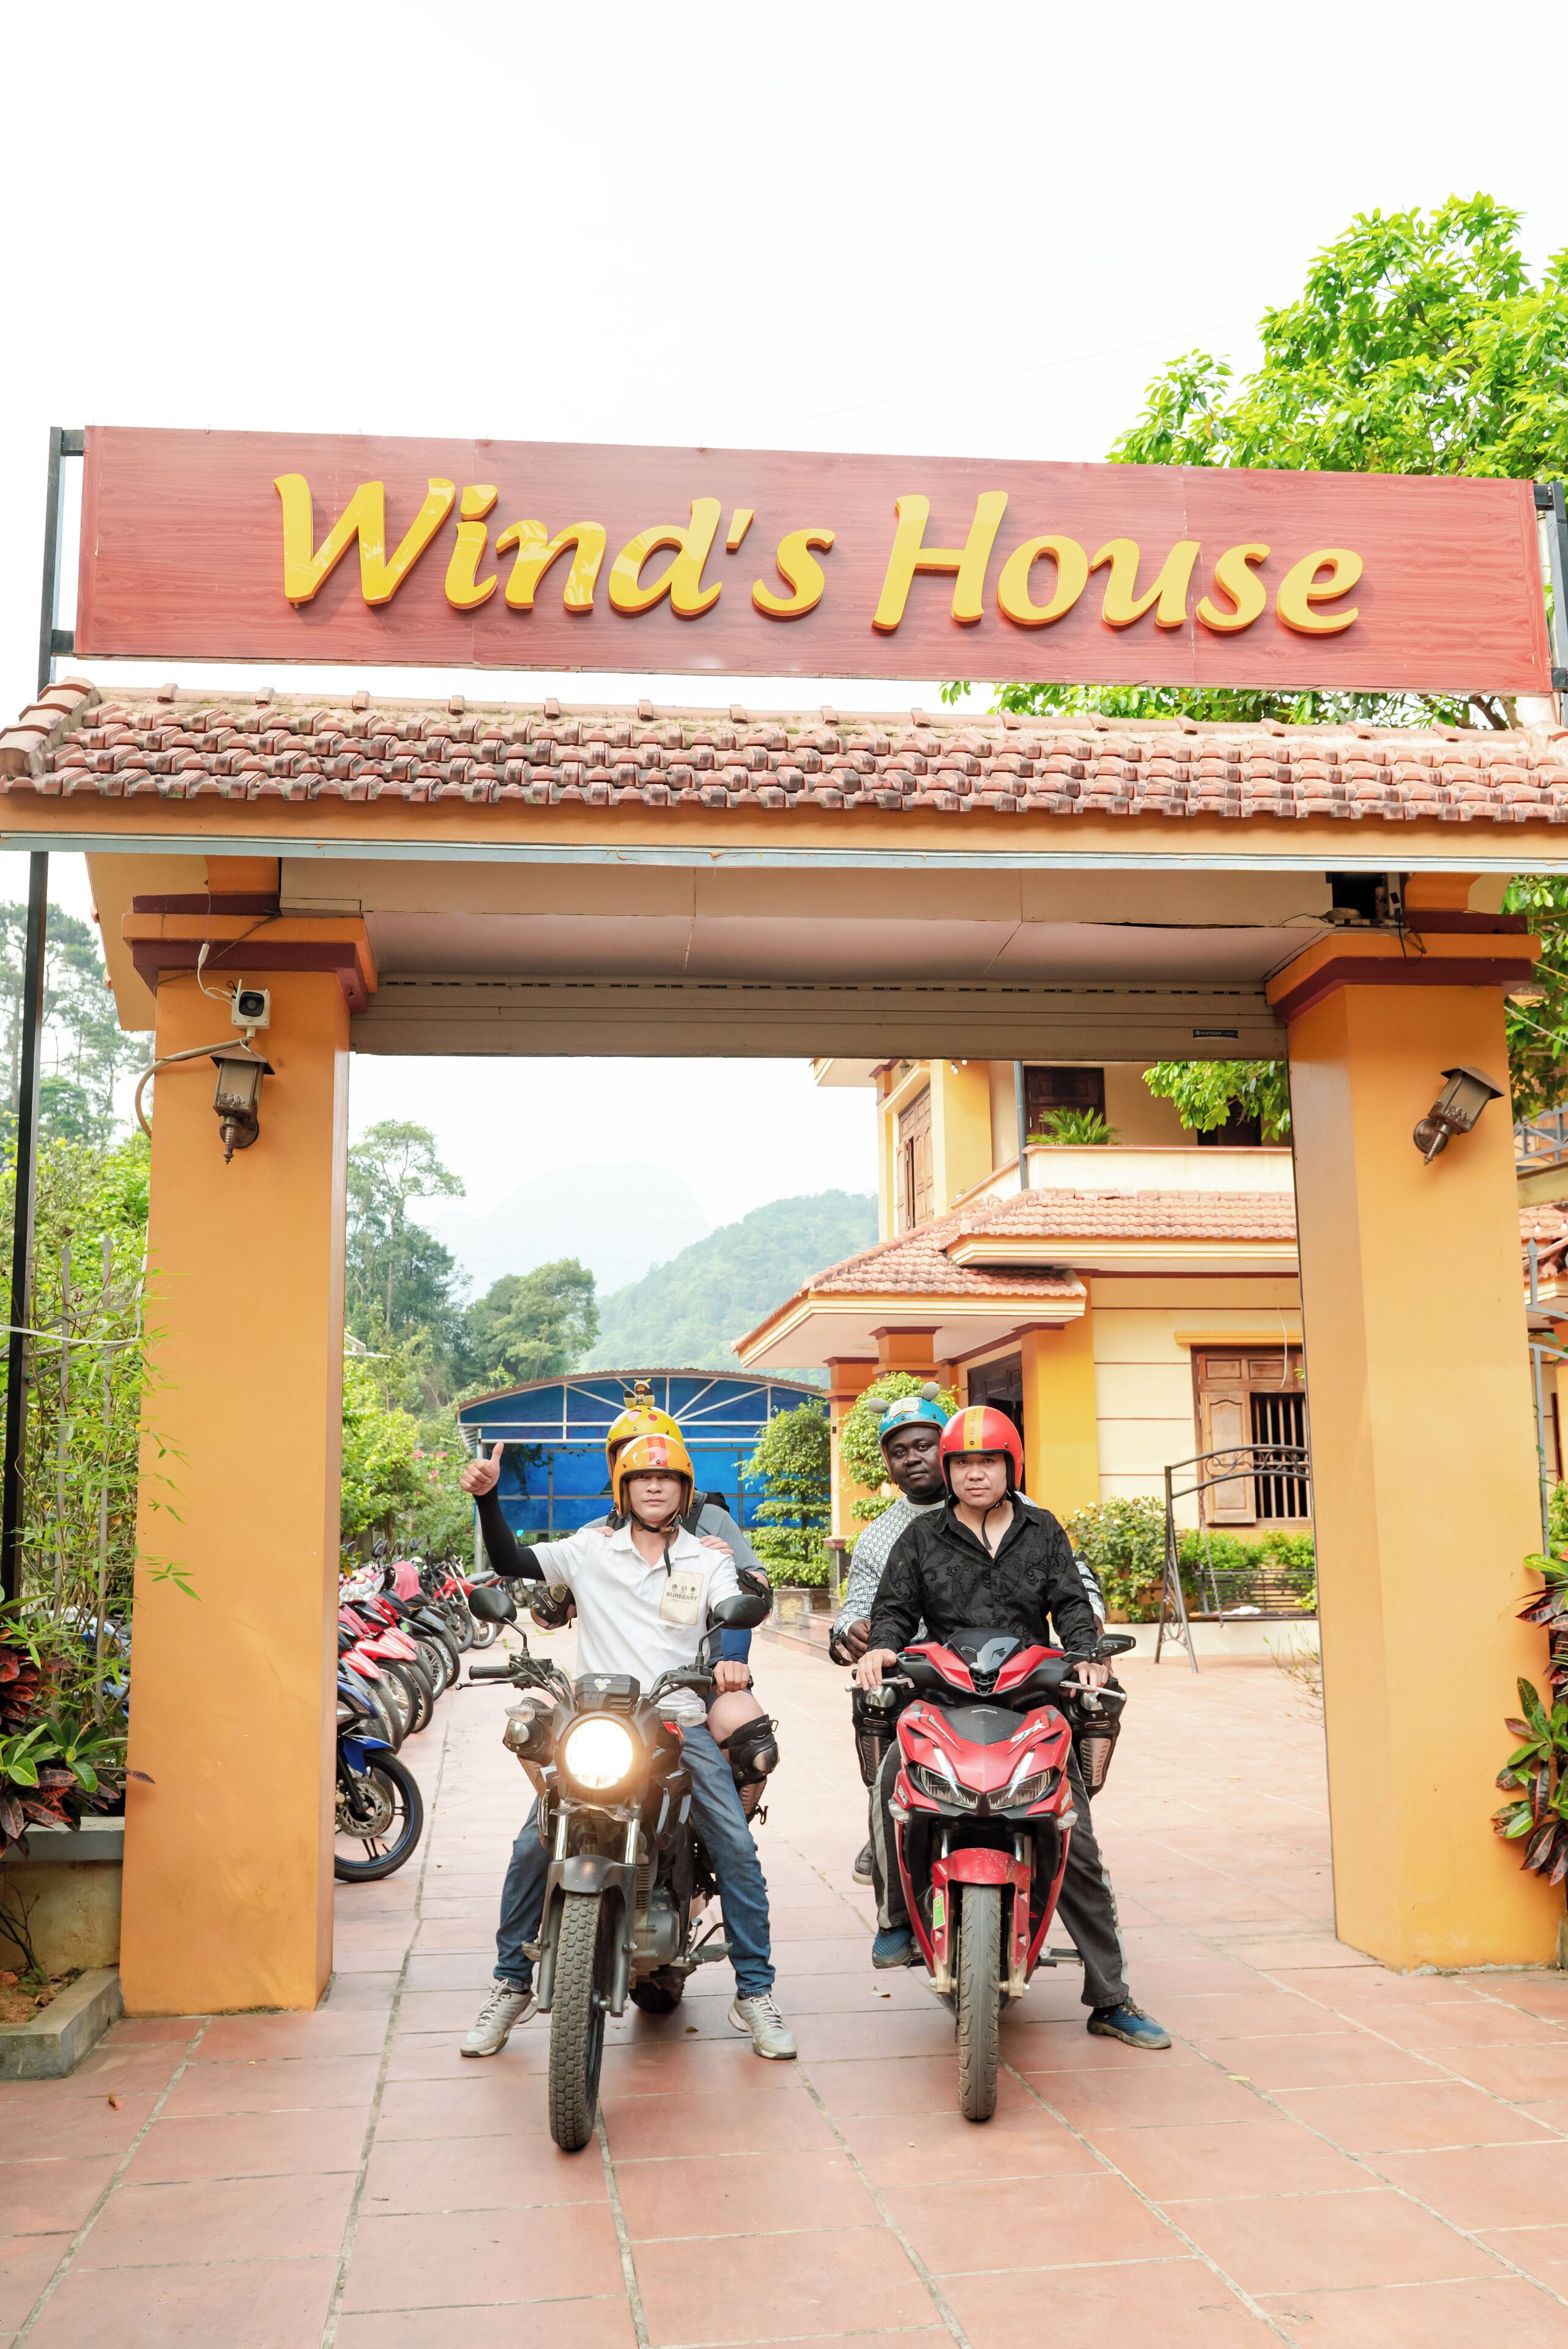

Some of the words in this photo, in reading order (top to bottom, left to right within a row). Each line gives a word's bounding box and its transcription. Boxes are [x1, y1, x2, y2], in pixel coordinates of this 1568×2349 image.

[272, 472, 836, 617] Wind's
[872, 490, 1364, 633] House
[666, 1592, 698, 1601] BURBERRY
